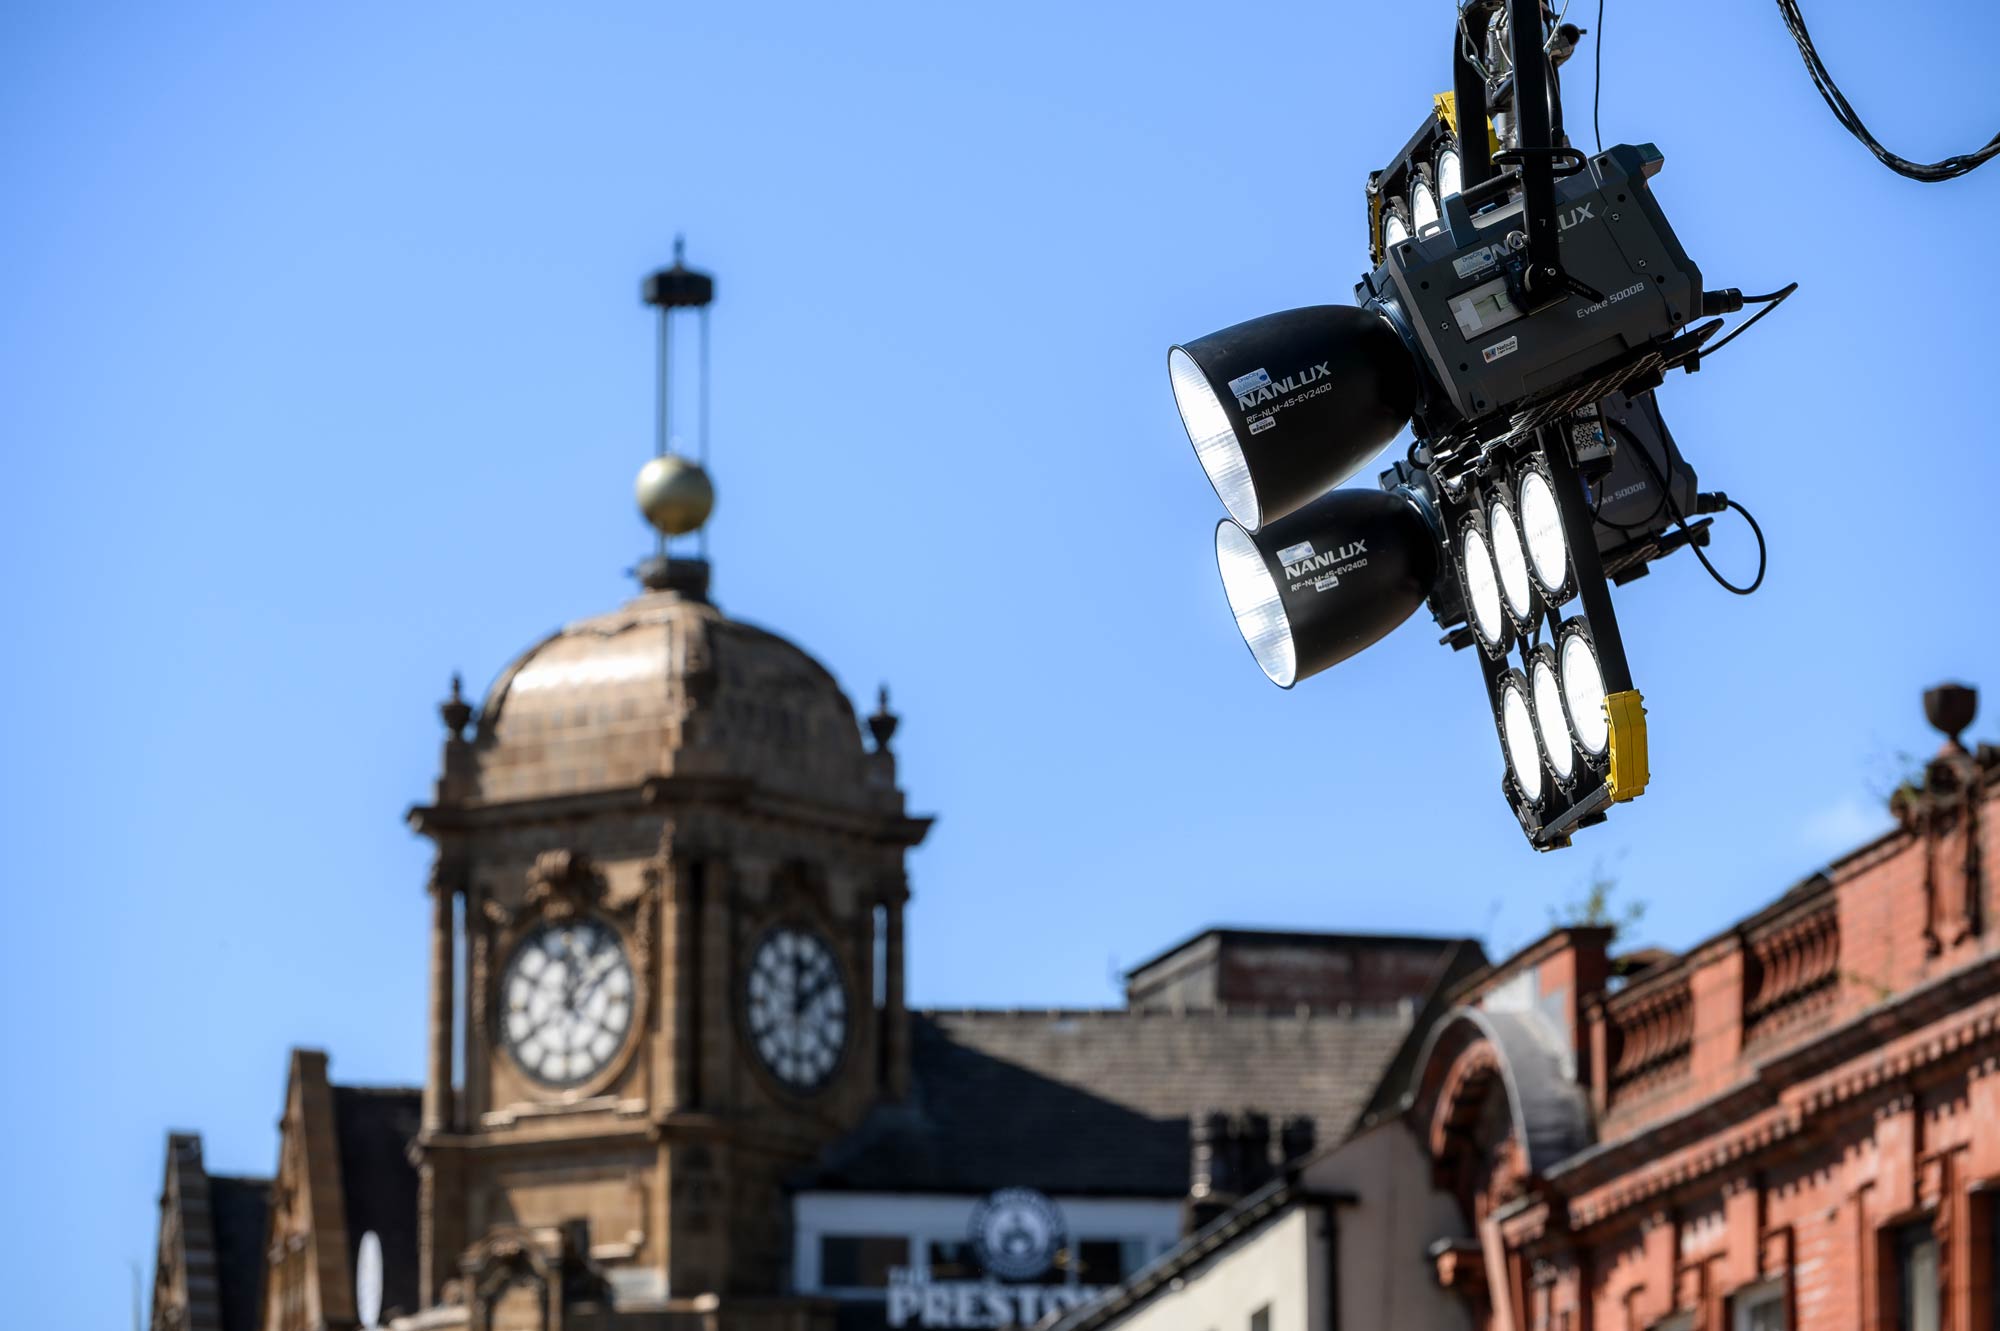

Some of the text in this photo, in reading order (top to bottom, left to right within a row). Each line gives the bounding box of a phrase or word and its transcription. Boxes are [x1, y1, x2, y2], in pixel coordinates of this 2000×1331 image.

[1576, 299, 1608, 319] Evoke
[1609, 282, 1645, 304] 5000B
[1238, 361, 1332, 412] NANLUX
[1246, 382, 1333, 425] RF-NLM-45-EV2400
[1284, 538, 1369, 581] NANLUX
[886, 1283, 1100, 1329] PRESTO
